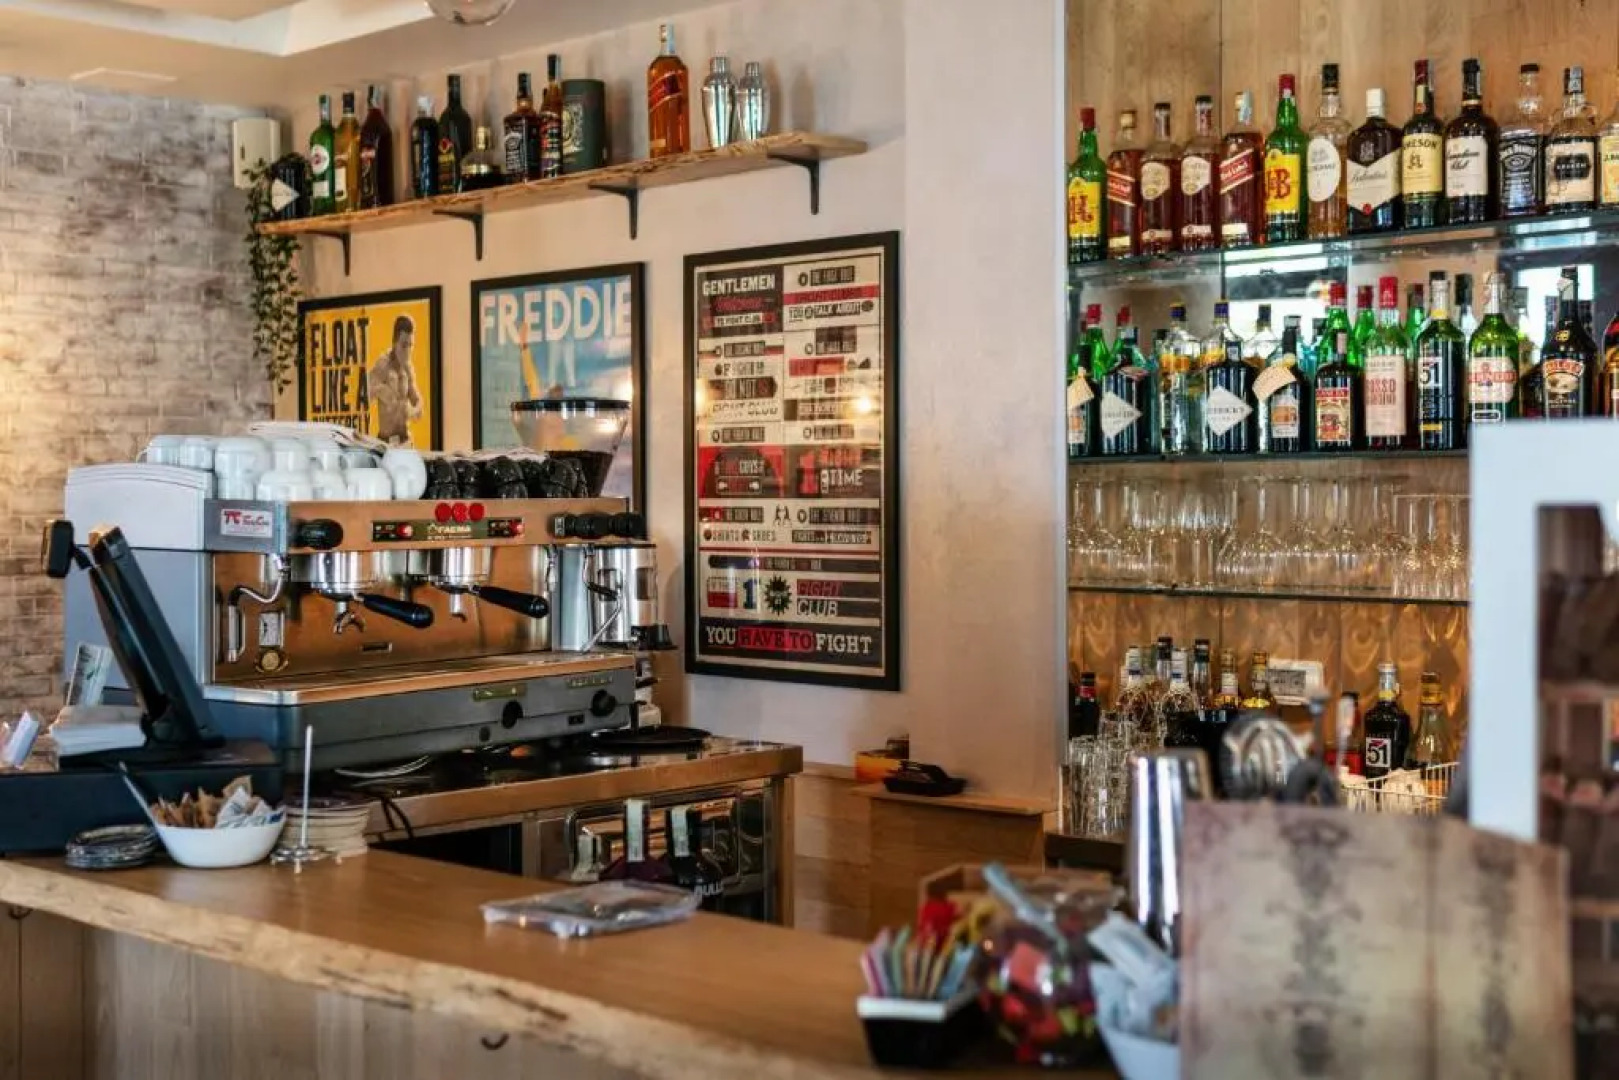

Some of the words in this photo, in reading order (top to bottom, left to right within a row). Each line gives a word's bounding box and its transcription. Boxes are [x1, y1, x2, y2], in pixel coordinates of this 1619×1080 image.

[1404, 139, 1438, 149] ESON
[702, 273, 776, 296] GENTLEMEN
[480, 281, 631, 347] FREDDIE
[310, 317, 369, 368] FLOAT
[1419, 361, 1440, 385] 51
[311, 368, 350, 413] LIKE
[356, 366, 368, 411] A
[829, 468, 864, 487] TIME
[797, 600, 839, 616] CLUB
[706, 625, 738, 645] YOU
[740, 628, 785, 648] HAVE
[790, 631, 813, 650] TO
[815, 633, 872, 653] FIGHT
[1367, 741, 1388, 765] 51
